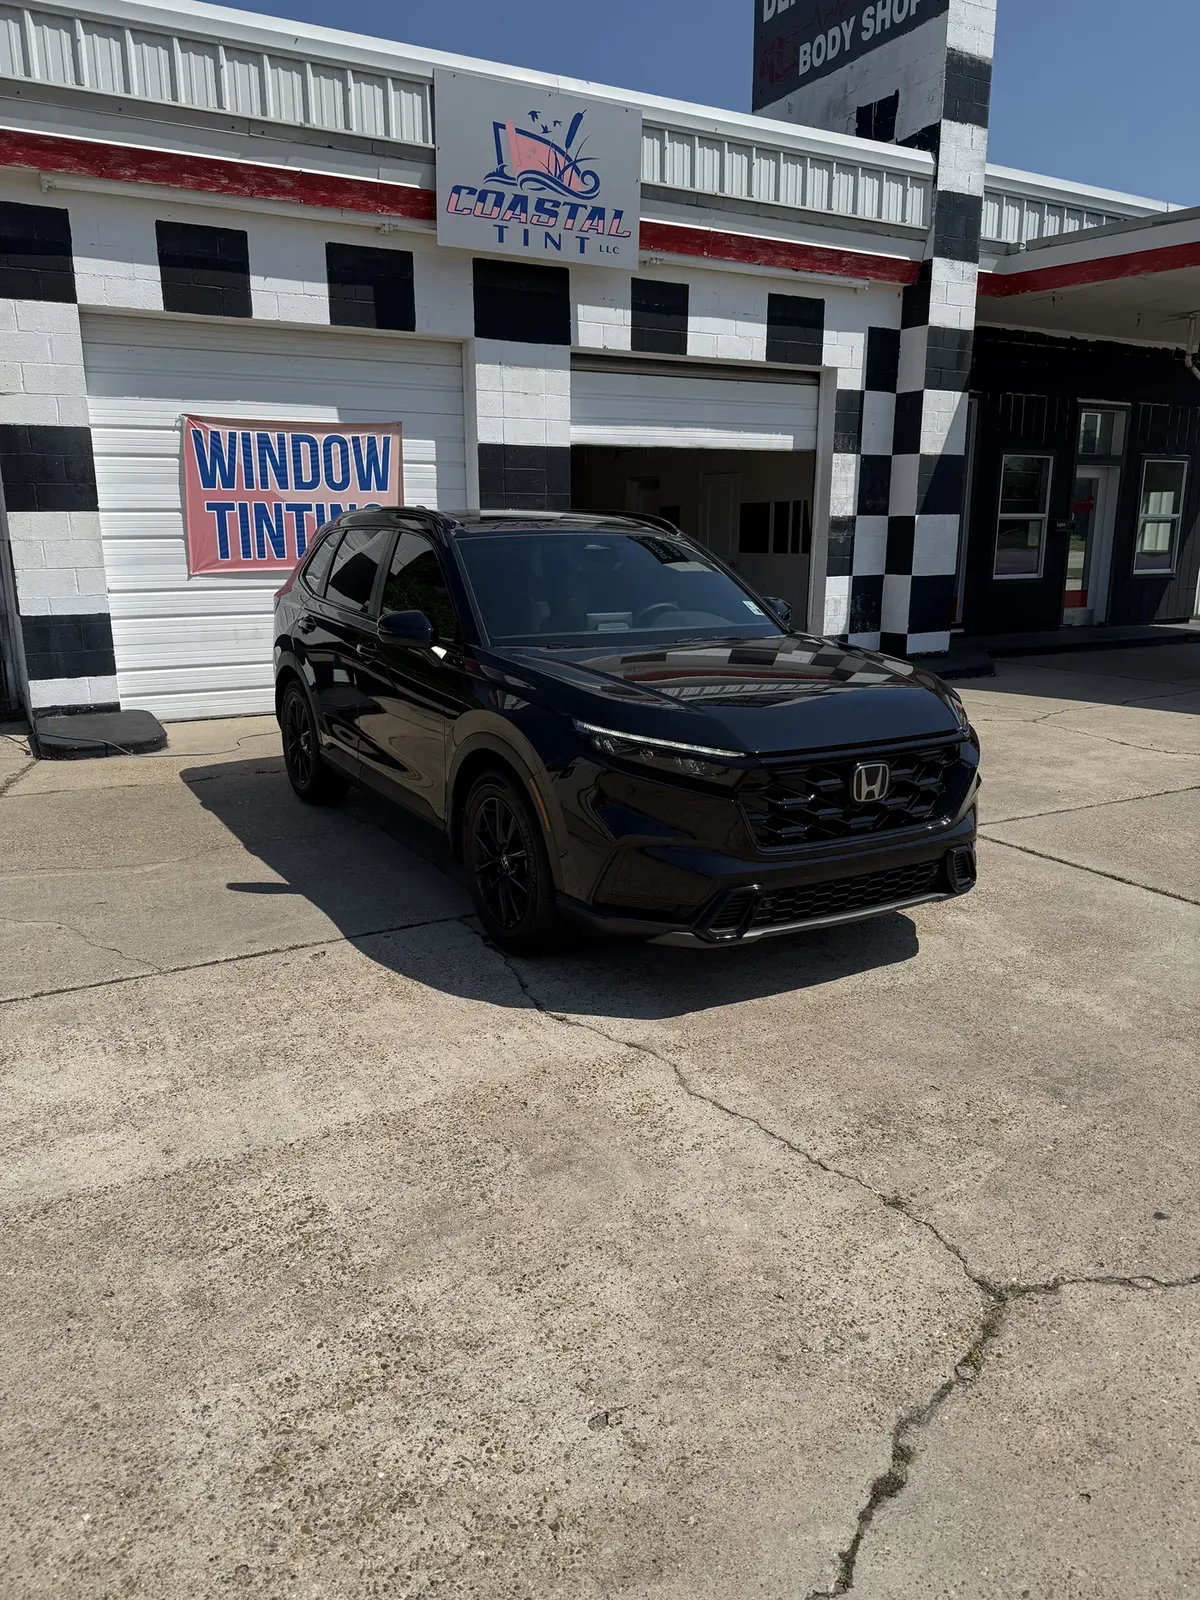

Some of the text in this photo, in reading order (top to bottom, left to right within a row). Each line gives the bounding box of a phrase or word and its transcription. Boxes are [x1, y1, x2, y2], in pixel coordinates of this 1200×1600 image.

[798, 14, 856, 76] BODY
[446, 184, 632, 238] COASTAL
[493, 224, 620, 255] TINT LLC
[190, 428, 392, 492] WINDOW
